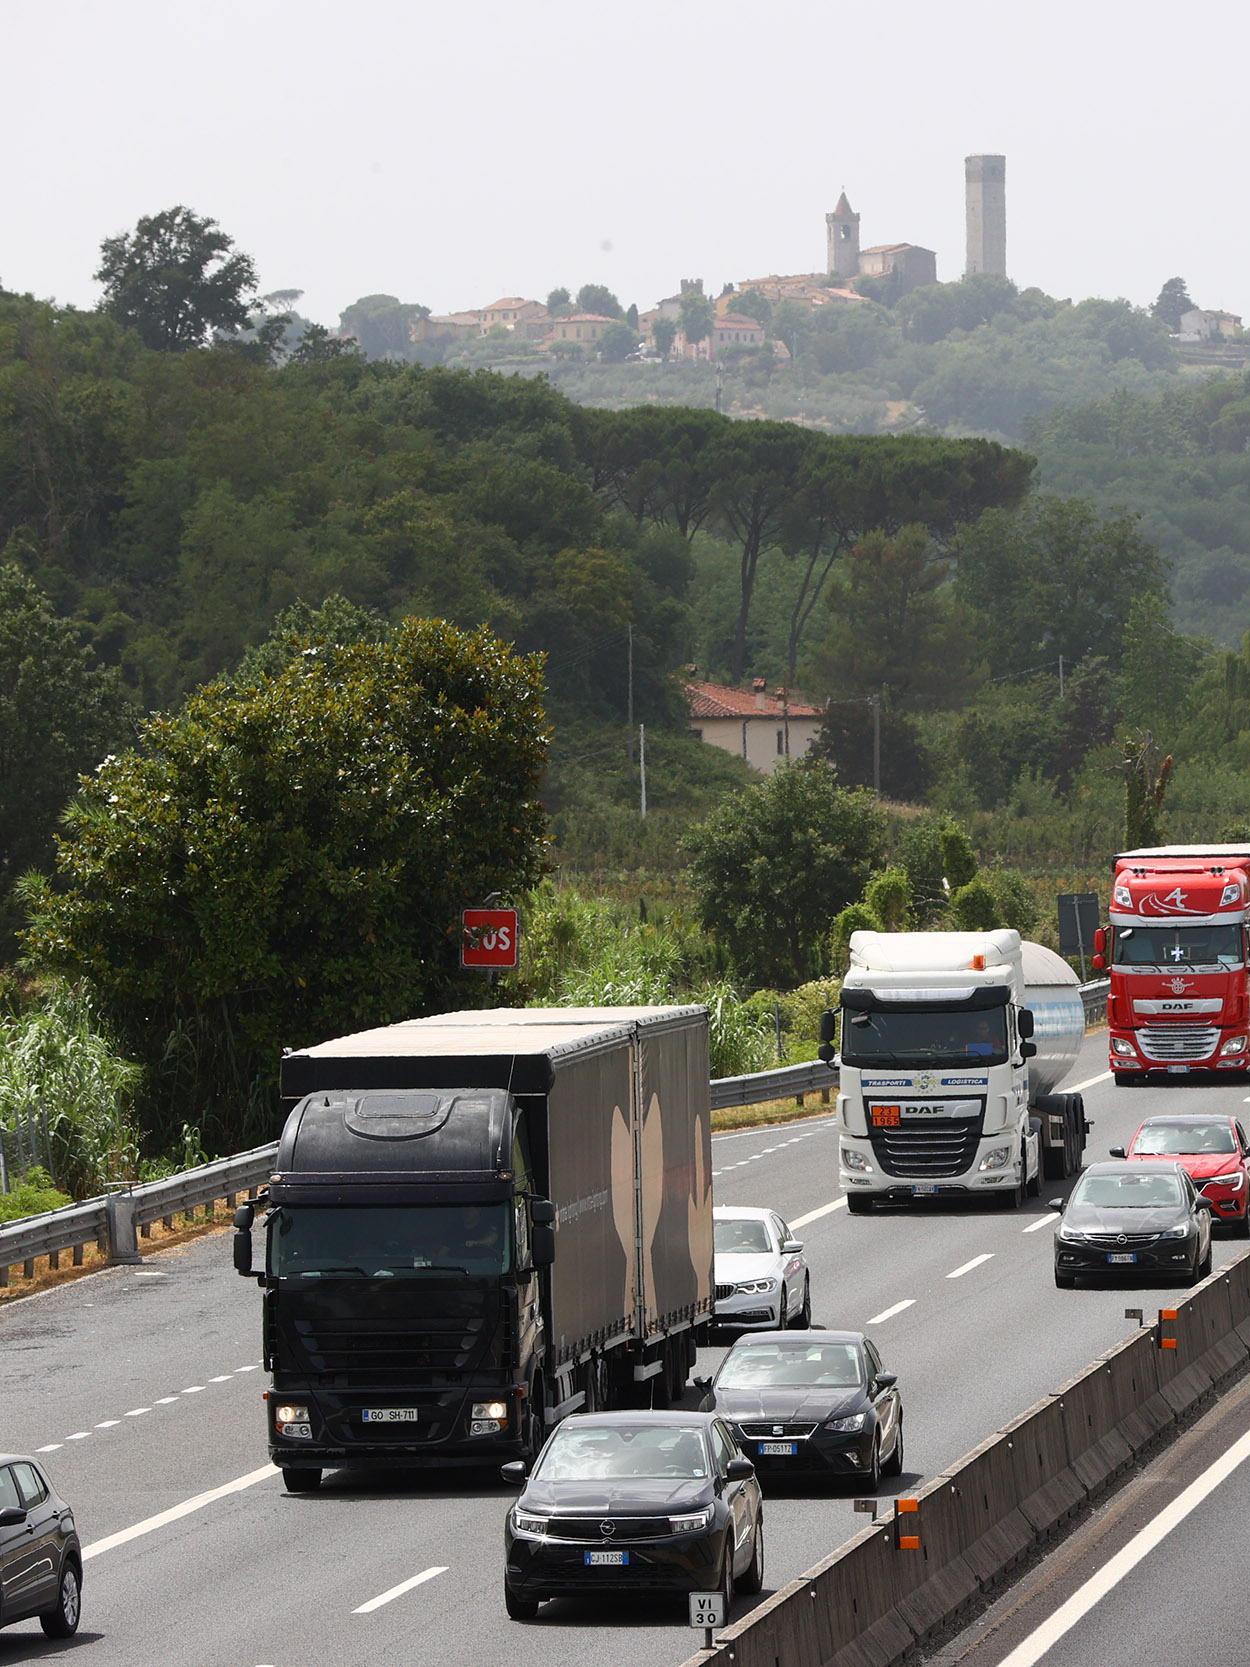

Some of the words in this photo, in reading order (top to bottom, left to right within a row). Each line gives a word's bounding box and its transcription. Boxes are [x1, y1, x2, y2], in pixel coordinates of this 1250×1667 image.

[471, 926, 511, 951] OS
[1162, 1002, 1193, 1010] DAF
[879, 1106, 892, 1115] 23
[905, 1105, 945, 1114] DAF
[874, 1116, 900, 1126] 1965
[697, 1599, 712, 1610] VI
[696, 1612, 717, 1624] 30
